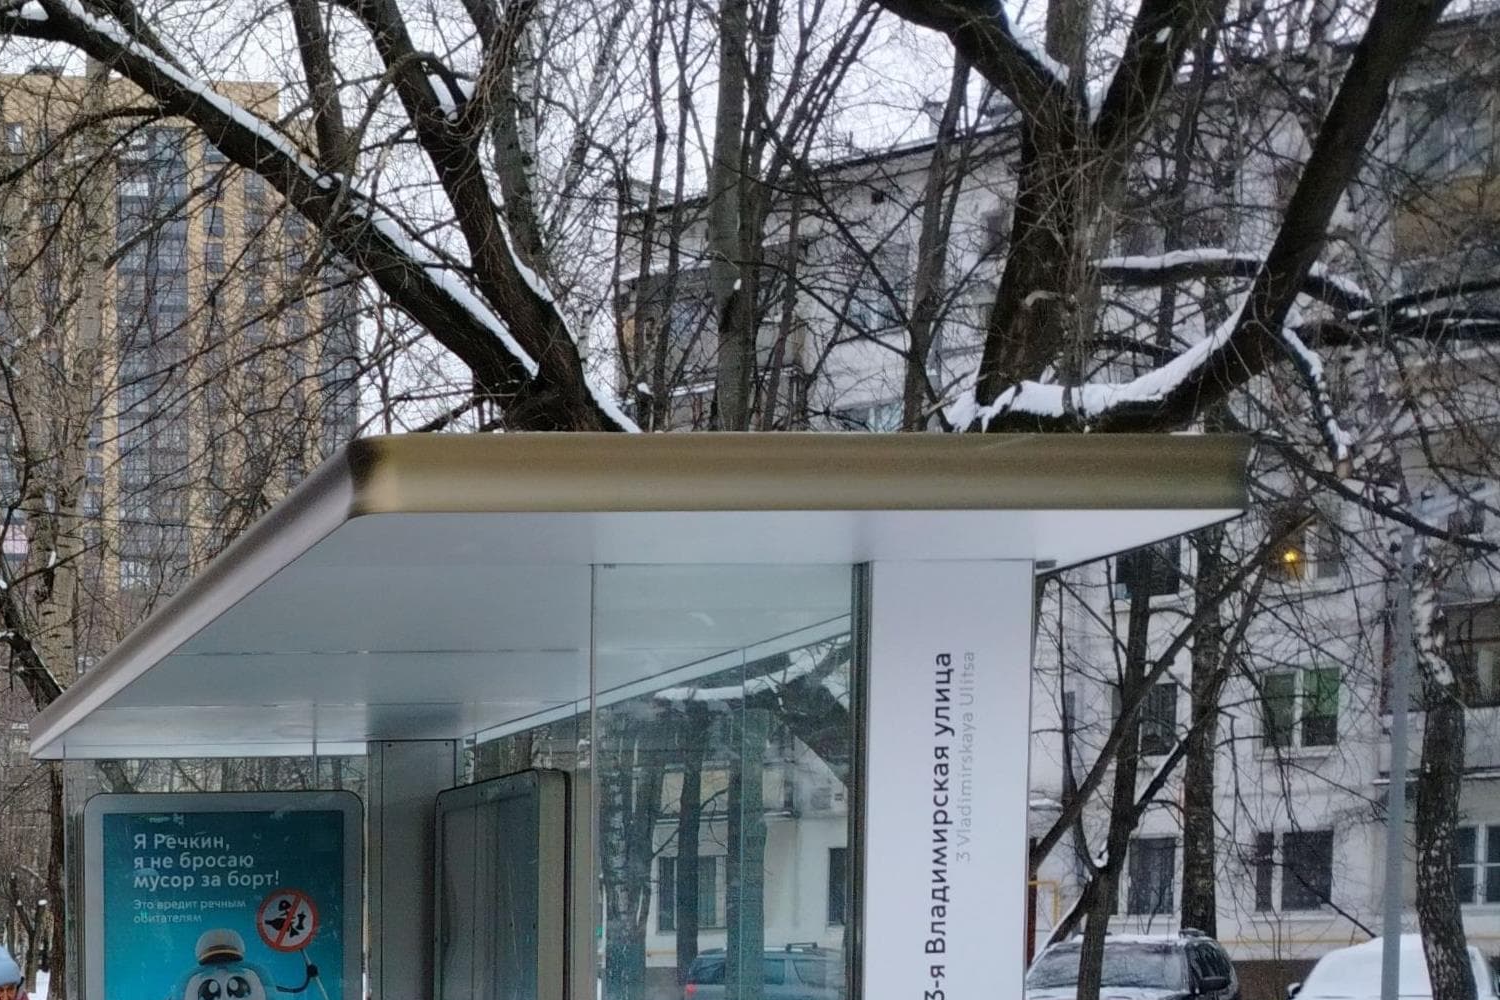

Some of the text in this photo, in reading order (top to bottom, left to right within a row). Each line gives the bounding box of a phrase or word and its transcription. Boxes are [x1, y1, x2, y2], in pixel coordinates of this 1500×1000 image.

[934, 652, 955, 737] улица
[959, 651, 975, 706] Ulitsa
[956, 712, 976, 848] Vladimirskaya
[134, 833, 230, 851] Я Речкин,
[924, 746, 953, 954] Владимирская
[134, 852, 254, 871] я не бросаю
[133, 870, 280, 892] мусор за борт!
[133, 899, 246, 911] Это вредит речным
